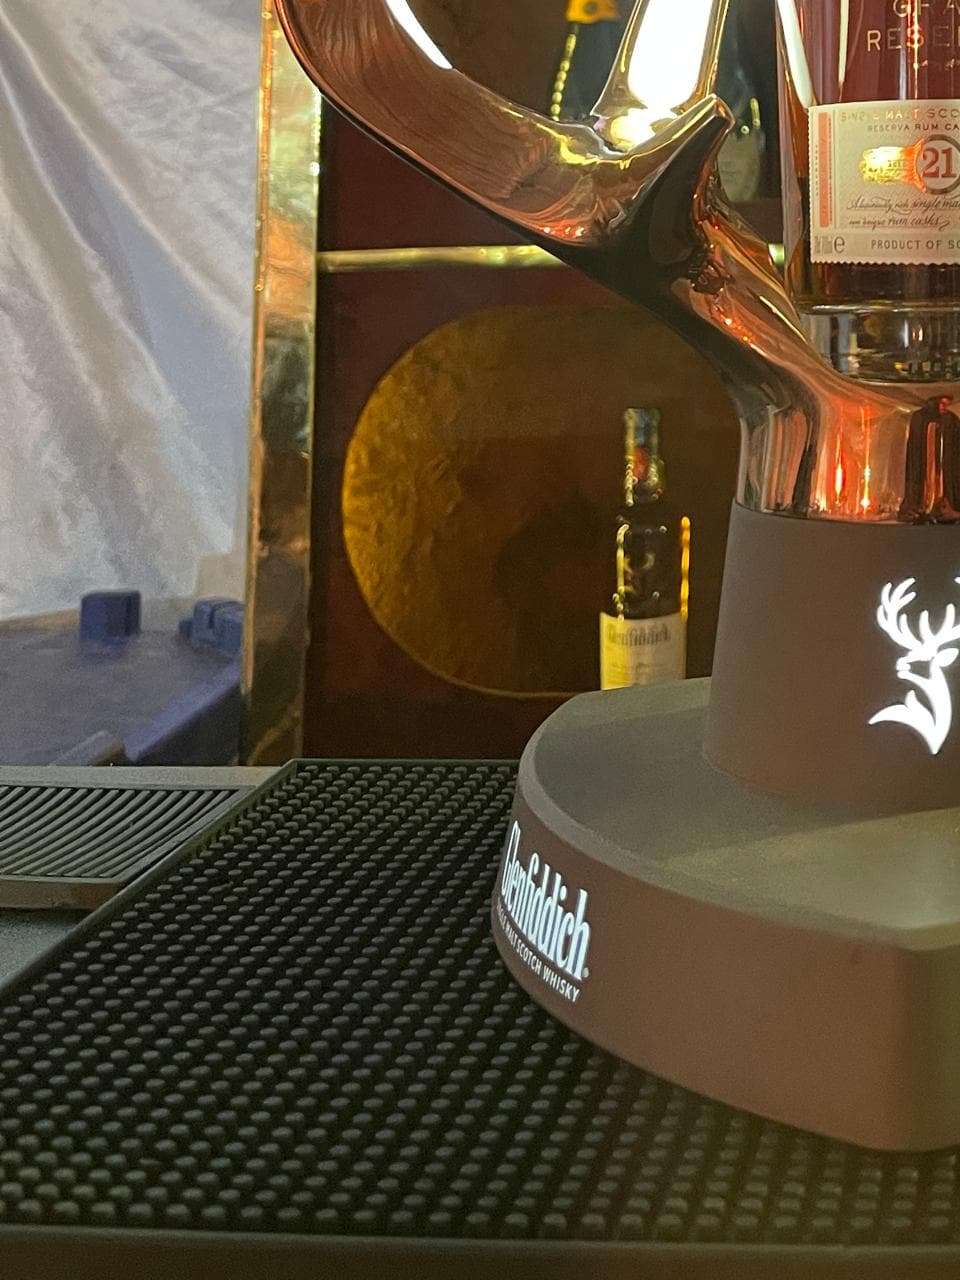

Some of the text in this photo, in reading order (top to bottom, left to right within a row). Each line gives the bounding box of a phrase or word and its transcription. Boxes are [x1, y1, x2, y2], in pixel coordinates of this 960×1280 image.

[914, 123, 939, 132] RUM
[921, 147, 957, 179] 21
[871, 239, 921, 250] PRODUCT
[925, 239, 942, 250] OF
[516, 936, 542, 976] SCOTCH
[543, 965, 580, 1003] WHISKY
